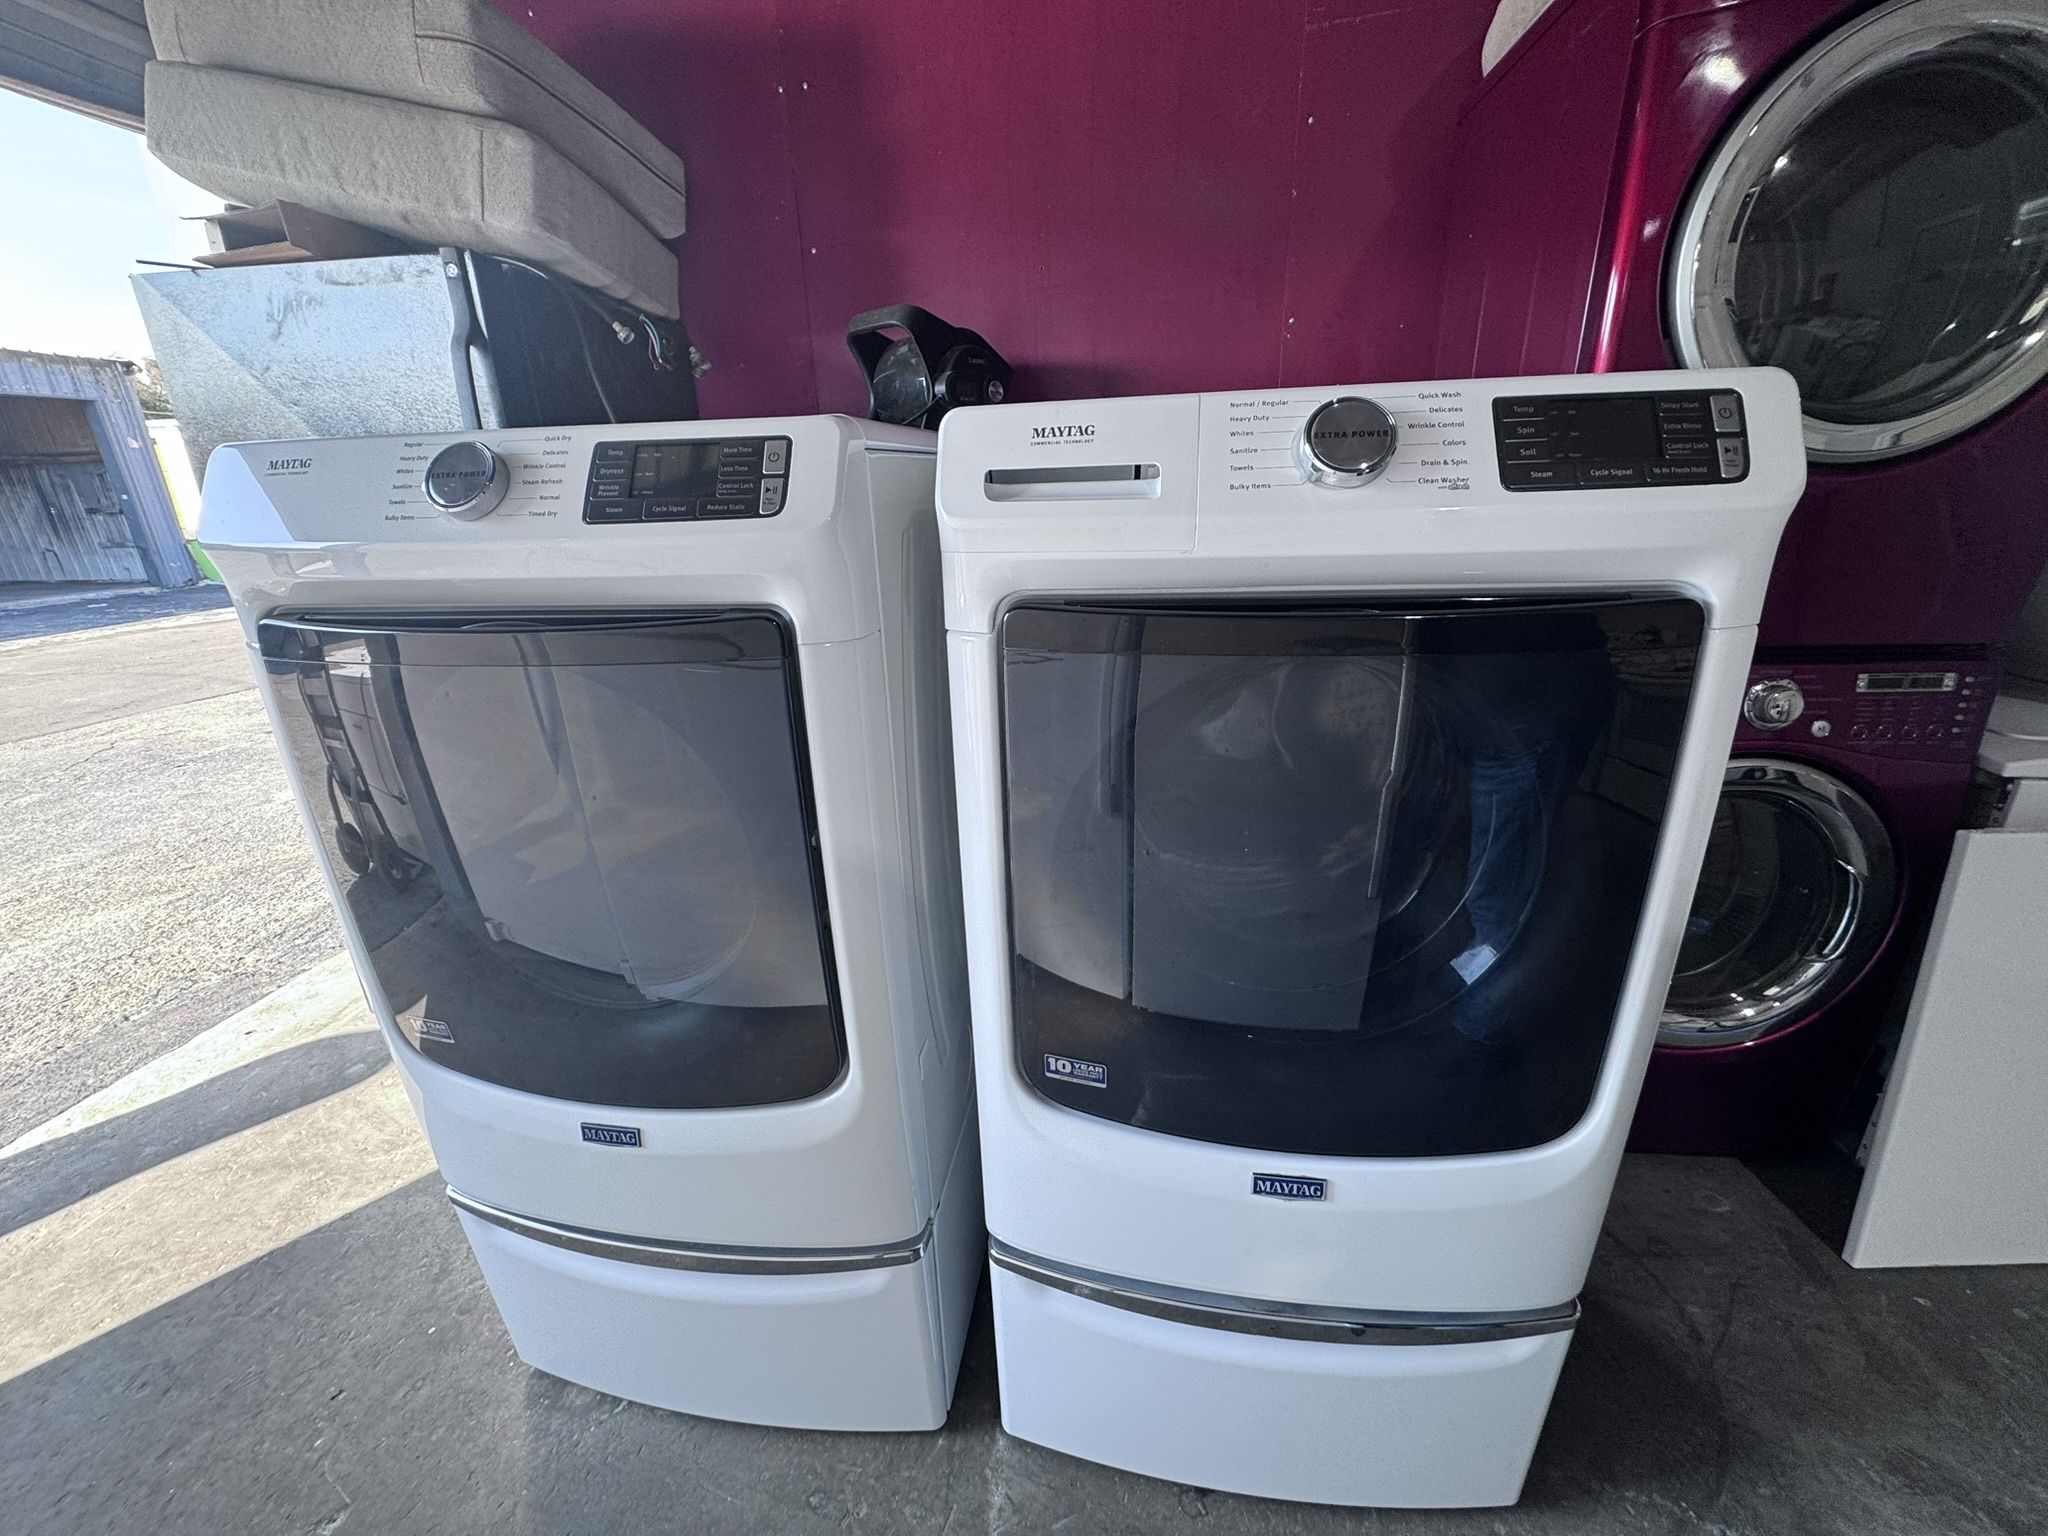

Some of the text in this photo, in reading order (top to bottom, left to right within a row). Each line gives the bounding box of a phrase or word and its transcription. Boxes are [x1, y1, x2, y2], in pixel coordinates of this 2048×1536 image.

[1262, 399, 1289, 407] Regular
[1513, 405, 1534, 413] Temp
[1032, 424, 1096, 439] MAYTAG
[1314, 429, 1390, 439] EXTRA POWER
[1517, 427, 1535, 435] Spin
[1693, 441, 1709, 449] Lock
[1520, 448, 1537, 456] Soil
[267, 458, 313, 471] MAYTAG
[1451, 458, 1468, 467] Spin
[600, 467, 624, 475] Dryness
[1590, 467, 1633, 476] Cycle Signal
[1671, 466, 1690, 474] Fresh
[431, 470, 487, 480] EXTRA POWER
[1440, 476, 1469, 484] Washer
[1230, 483, 1250, 491] Bulky
[652, 504, 687, 513] Cycle Signal
[410, 1018, 446, 1032] 10 YEAR
[1047, 1057, 1103, 1073] 10 YEAR
[583, 1128, 636, 1145] MAYTAG
[1256, 1178, 1322, 1198] MAYTAG
